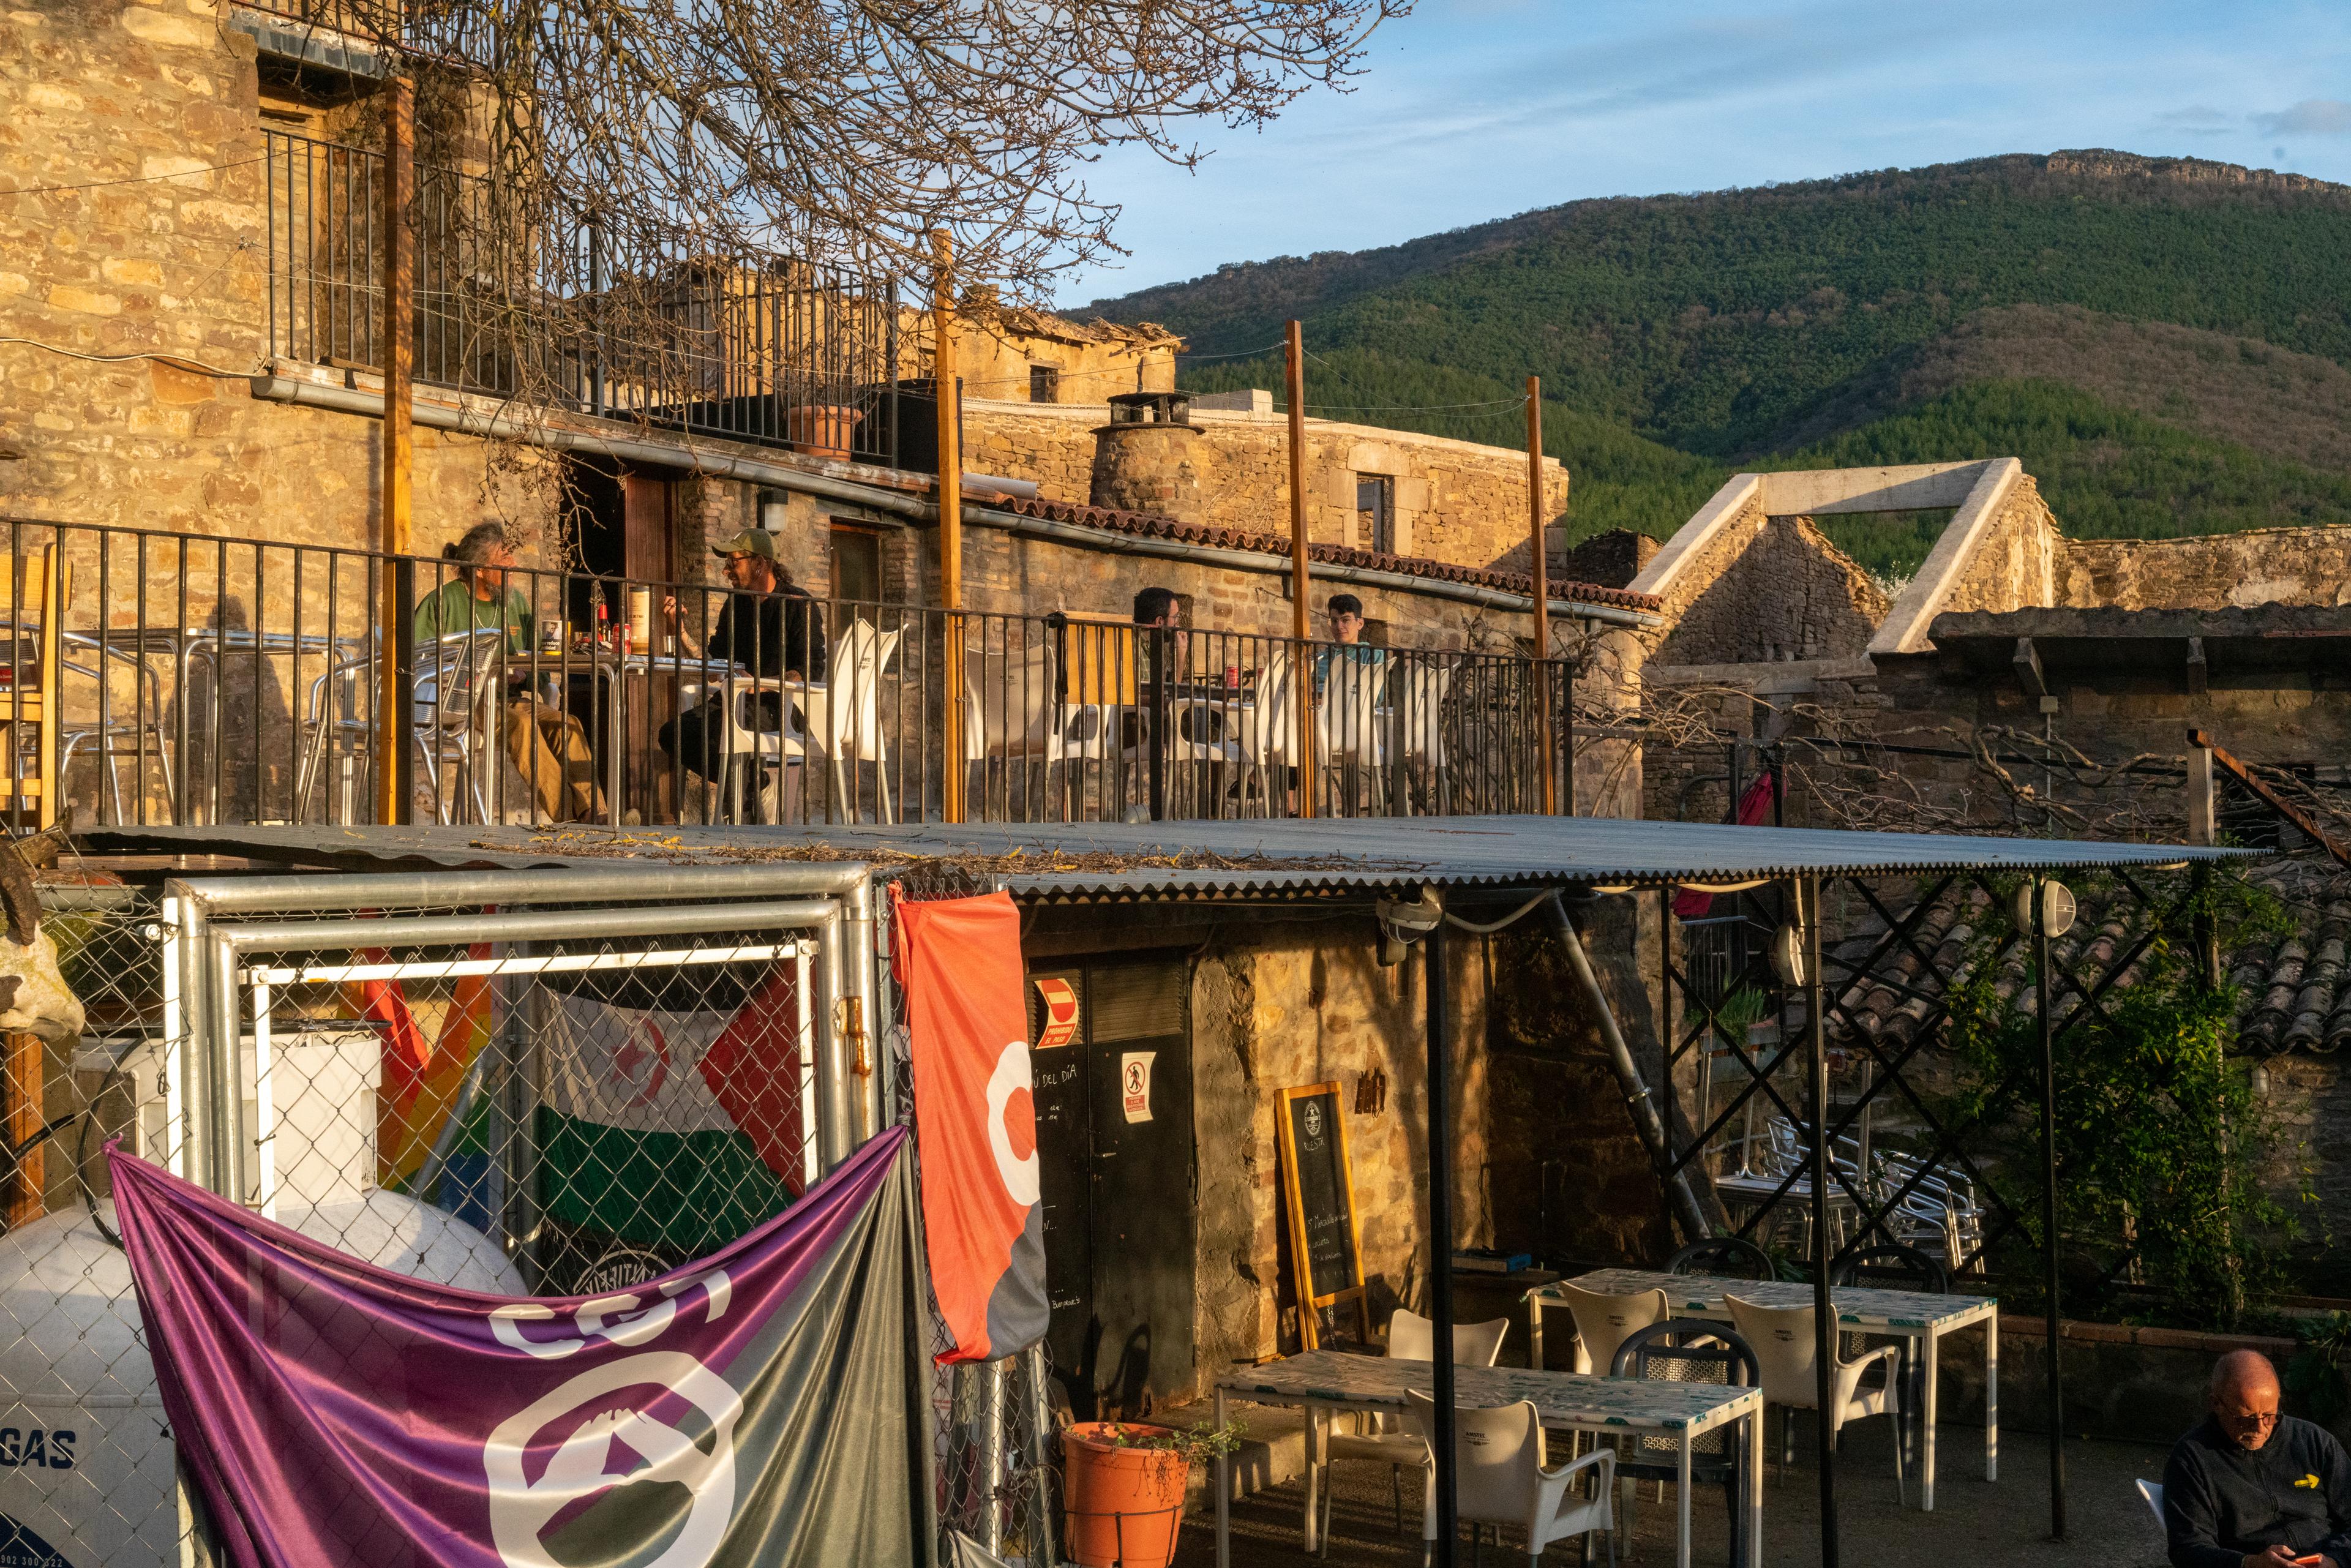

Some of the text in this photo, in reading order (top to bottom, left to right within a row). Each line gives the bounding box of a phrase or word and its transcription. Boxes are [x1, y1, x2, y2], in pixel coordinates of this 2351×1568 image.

[1048, 1026, 1072, 1035] PROHIBIDO
[1043, 1073, 1058, 1087] DEL
[1062, 1064, 1078, 1082] DÍA
[1303, 1136, 1325, 1152] RUESTA
[488, 1265, 732, 1360] CGT
[0, 1427, 76, 1469] GAS
[1, 1555, 17, 1565] 902
[22, 1556, 39, 1566] 300
